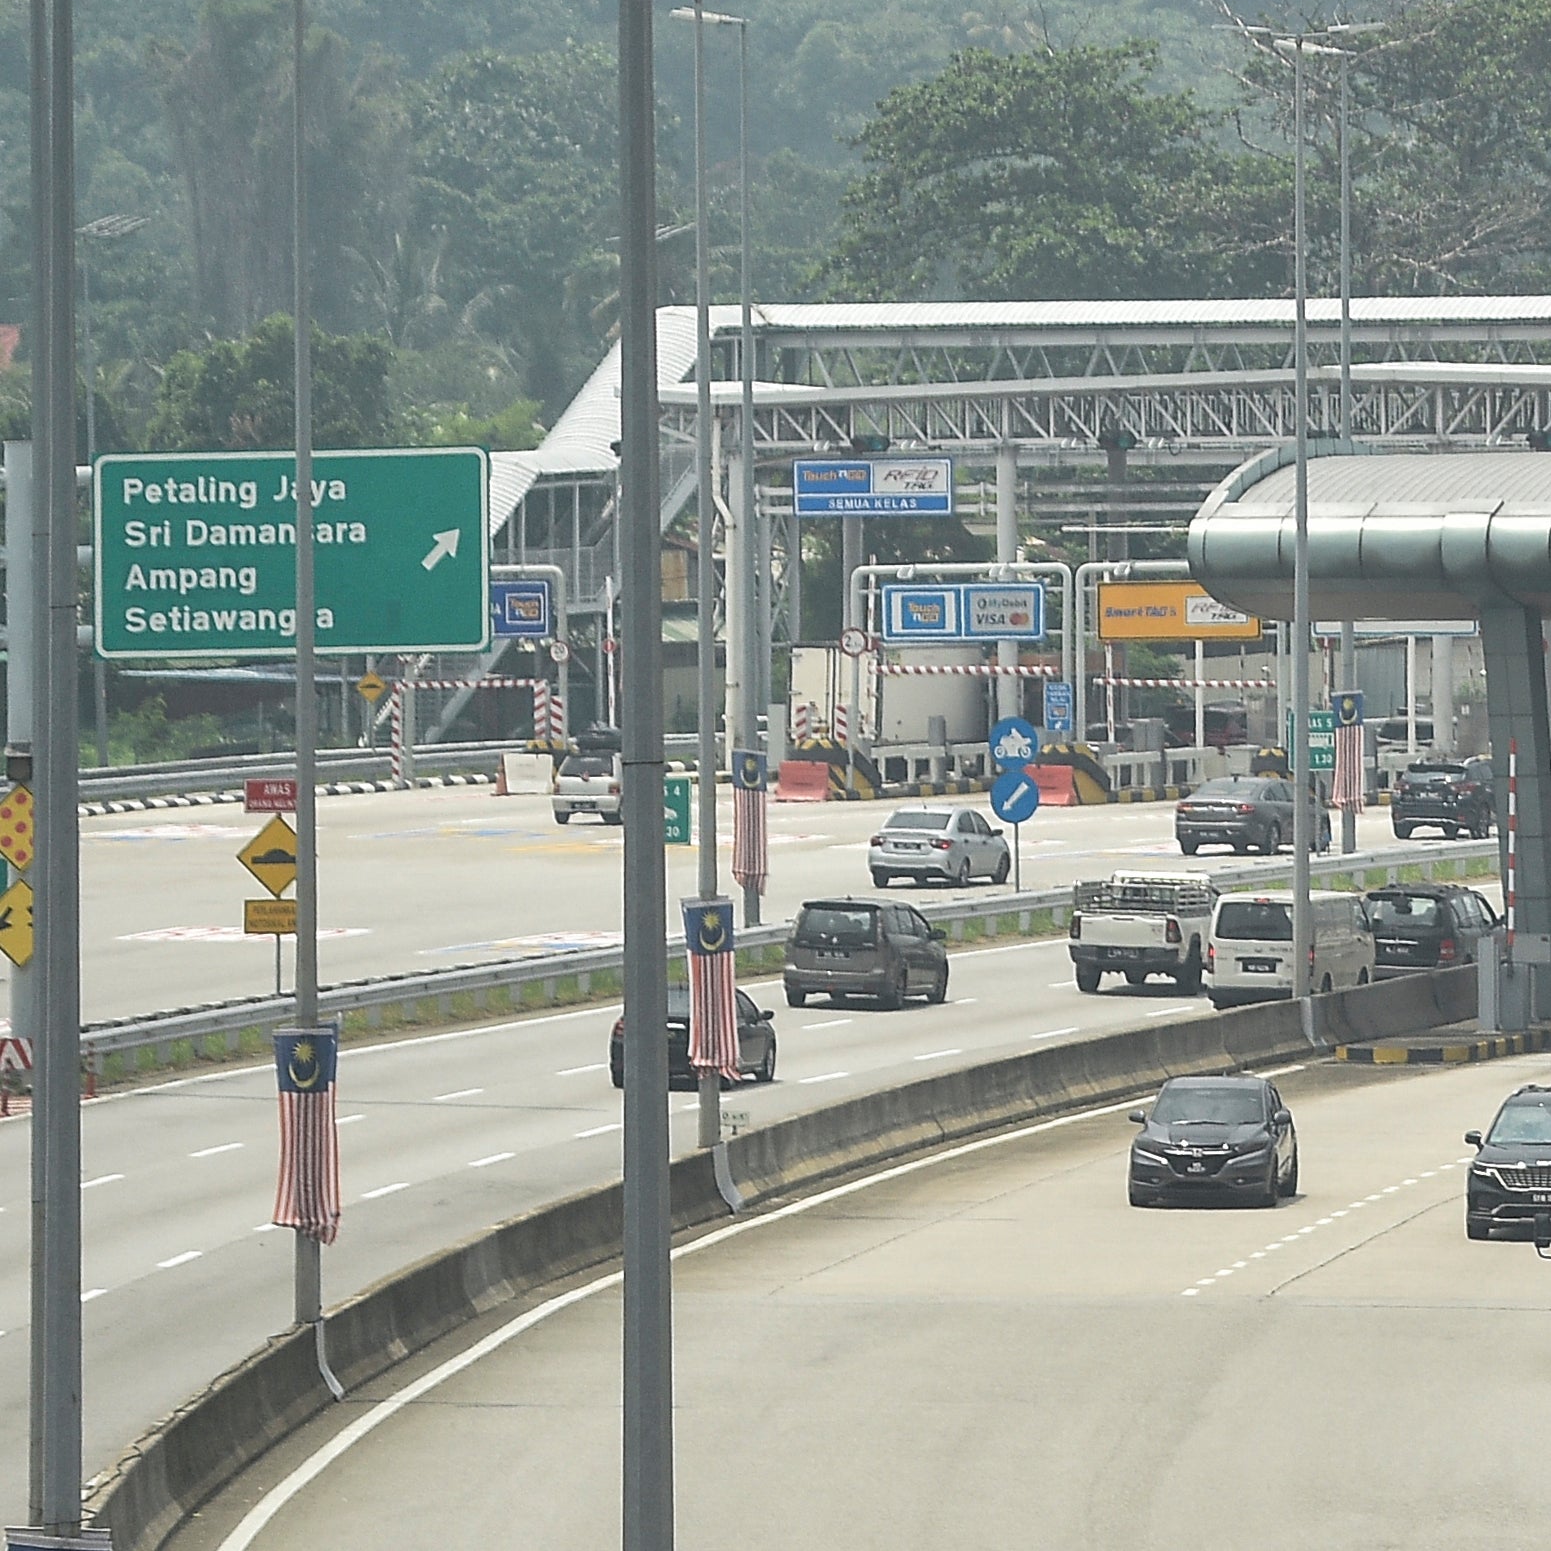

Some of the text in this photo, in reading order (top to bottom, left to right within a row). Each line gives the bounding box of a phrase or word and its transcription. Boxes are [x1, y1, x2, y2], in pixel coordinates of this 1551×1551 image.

[123, 476, 258, 509] Petaling
[828, 498, 918, 509] SEMUA KELAS
[124, 519, 367, 547] Sri Damanara
[125, 563, 257, 595] Ampang
[125, 605, 335, 637] Setiawanga
[976, 613, 1006, 625] VISA
